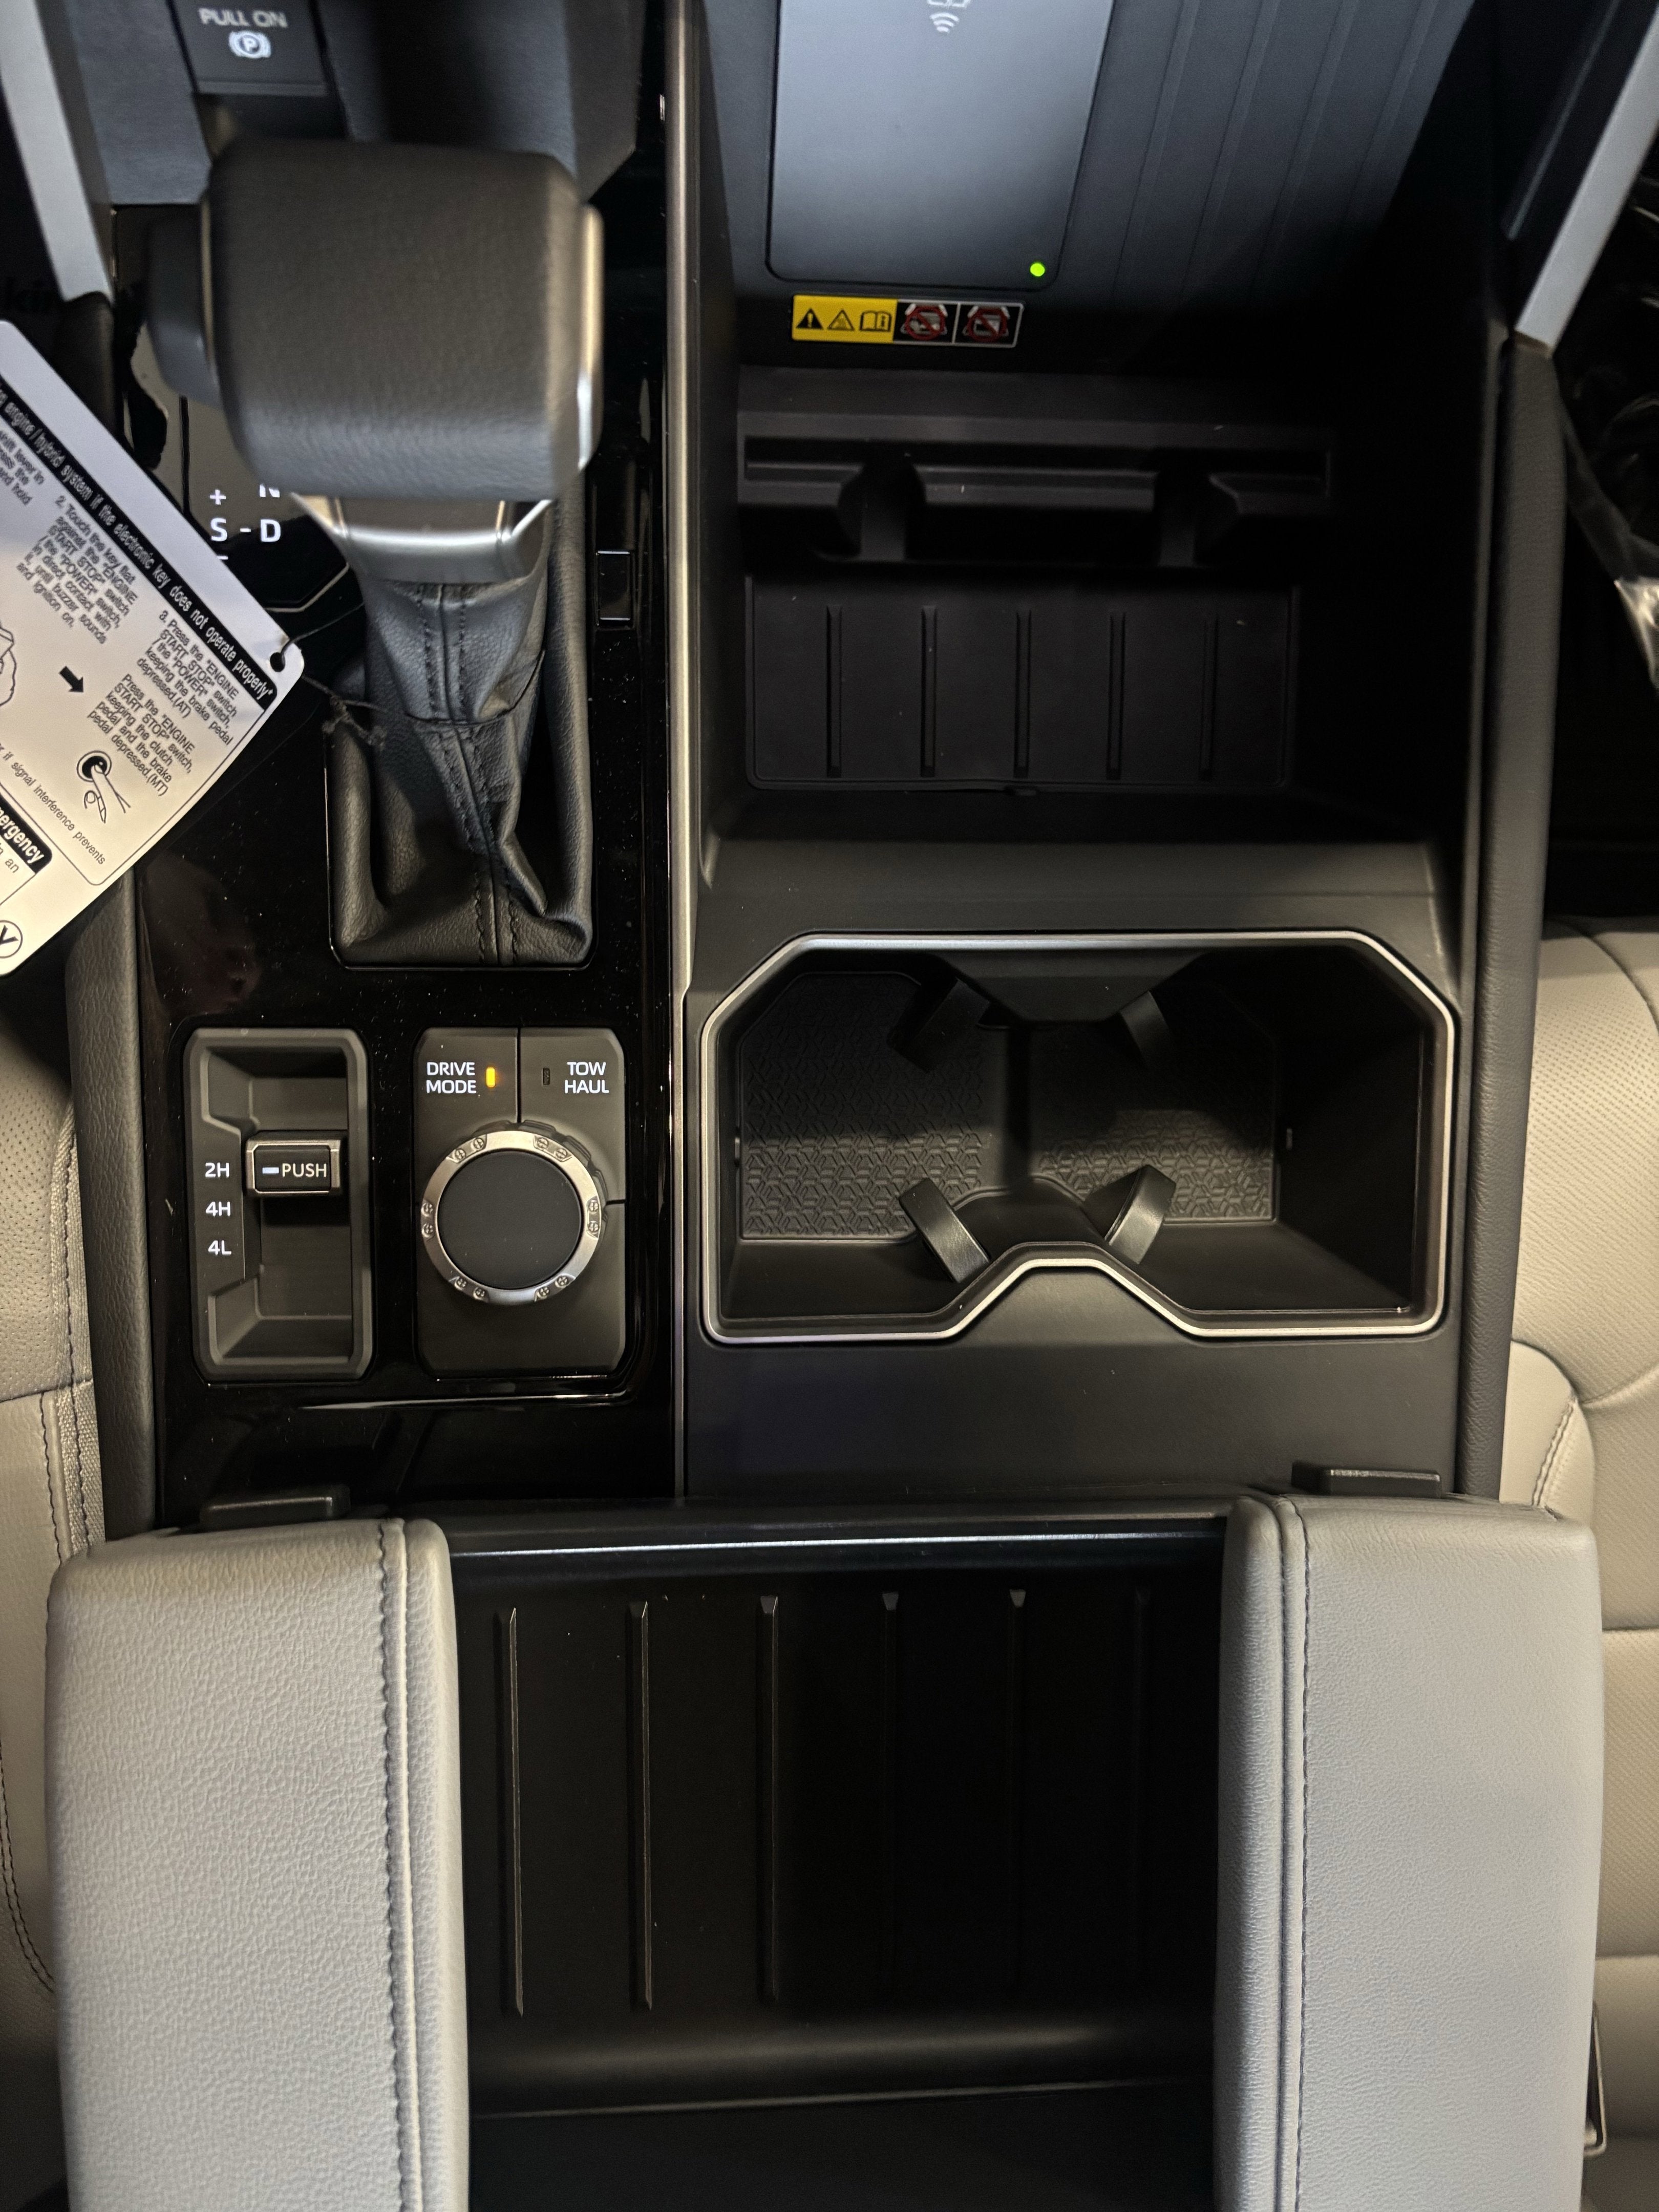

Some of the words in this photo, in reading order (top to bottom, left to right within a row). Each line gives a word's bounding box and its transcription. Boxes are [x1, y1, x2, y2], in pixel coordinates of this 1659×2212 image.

[199, 8, 249, 26] PULL
[252, 10, 288, 28] ON
[43, 539, 57, 556] the
[65, 503, 91, 536] Touch
[89, 532, 105, 552] the
[102, 547, 121, 571] key
[210, 517, 228, 542] S
[260, 518, 282, 543] D
[48, 524, 78, 555] START
[104, 588, 130, 616] switch
[60, 464, 93, 500] system
[98, 504, 116, 525] the
[114, 523, 154, 568] electronic
[152, 563, 171, 589] key
[169, 585, 192, 611] does
[190, 609, 208, 629] not
[205, 626, 236, 661] operate
[84, 546, 99, 564] the
[16, 562, 35, 581] and
[33, 580, 61, 611] ignition
[41, 554, 67, 580] direct
[65, 580, 95, 612] contact
[94, 611, 111, 631] with
[51, 582, 79, 611] buzzer
[79, 613, 107, 644] sounds
[166, 619, 189, 646] Press
[189, 644, 203, 661] the
[156, 642, 171, 659] the
[206, 698, 230, 729] switch,
[160, 628, 189, 659] START
[213, 690, 237, 717] switch
[121, 673, 144, 700] Press
[143, 698, 159, 716] the
[144, 646, 175, 683] keeping
[174, 679, 188, 696] the
[188, 694, 210, 721] brake
[208, 720, 233, 746] pedal
[86, 710, 113, 734] pedal
[95, 701, 121, 726] pedal
[119, 724, 138, 743] and
[135, 741, 150, 759] the
[149, 756, 172, 782] brake
[105, 690, 136, 727] keeping
[135, 723, 150, 740] the
[149, 740, 173, 767] clutch
[114, 682, 143, 712] START
[165, 743, 192, 773] switch,
[2, 751, 14, 761] if
[11, 762, 36, 786] signal
[33, 784, 75, 831] interference
[72, 831, 105, 864] prevents
[4, 858, 19, 873] an
[426, 1061, 476, 1076] DRIVE
[426, 1079, 477, 1094] MODE
[564, 1079, 610, 1094] HAUL
[567, 1061, 607, 1076] TOW
[205, 1162, 230, 1178] 2H
[282, 1163, 327, 1178] PUSH
[205, 1201, 231, 1217] 4H
[207, 1240, 232, 1256] 4L
